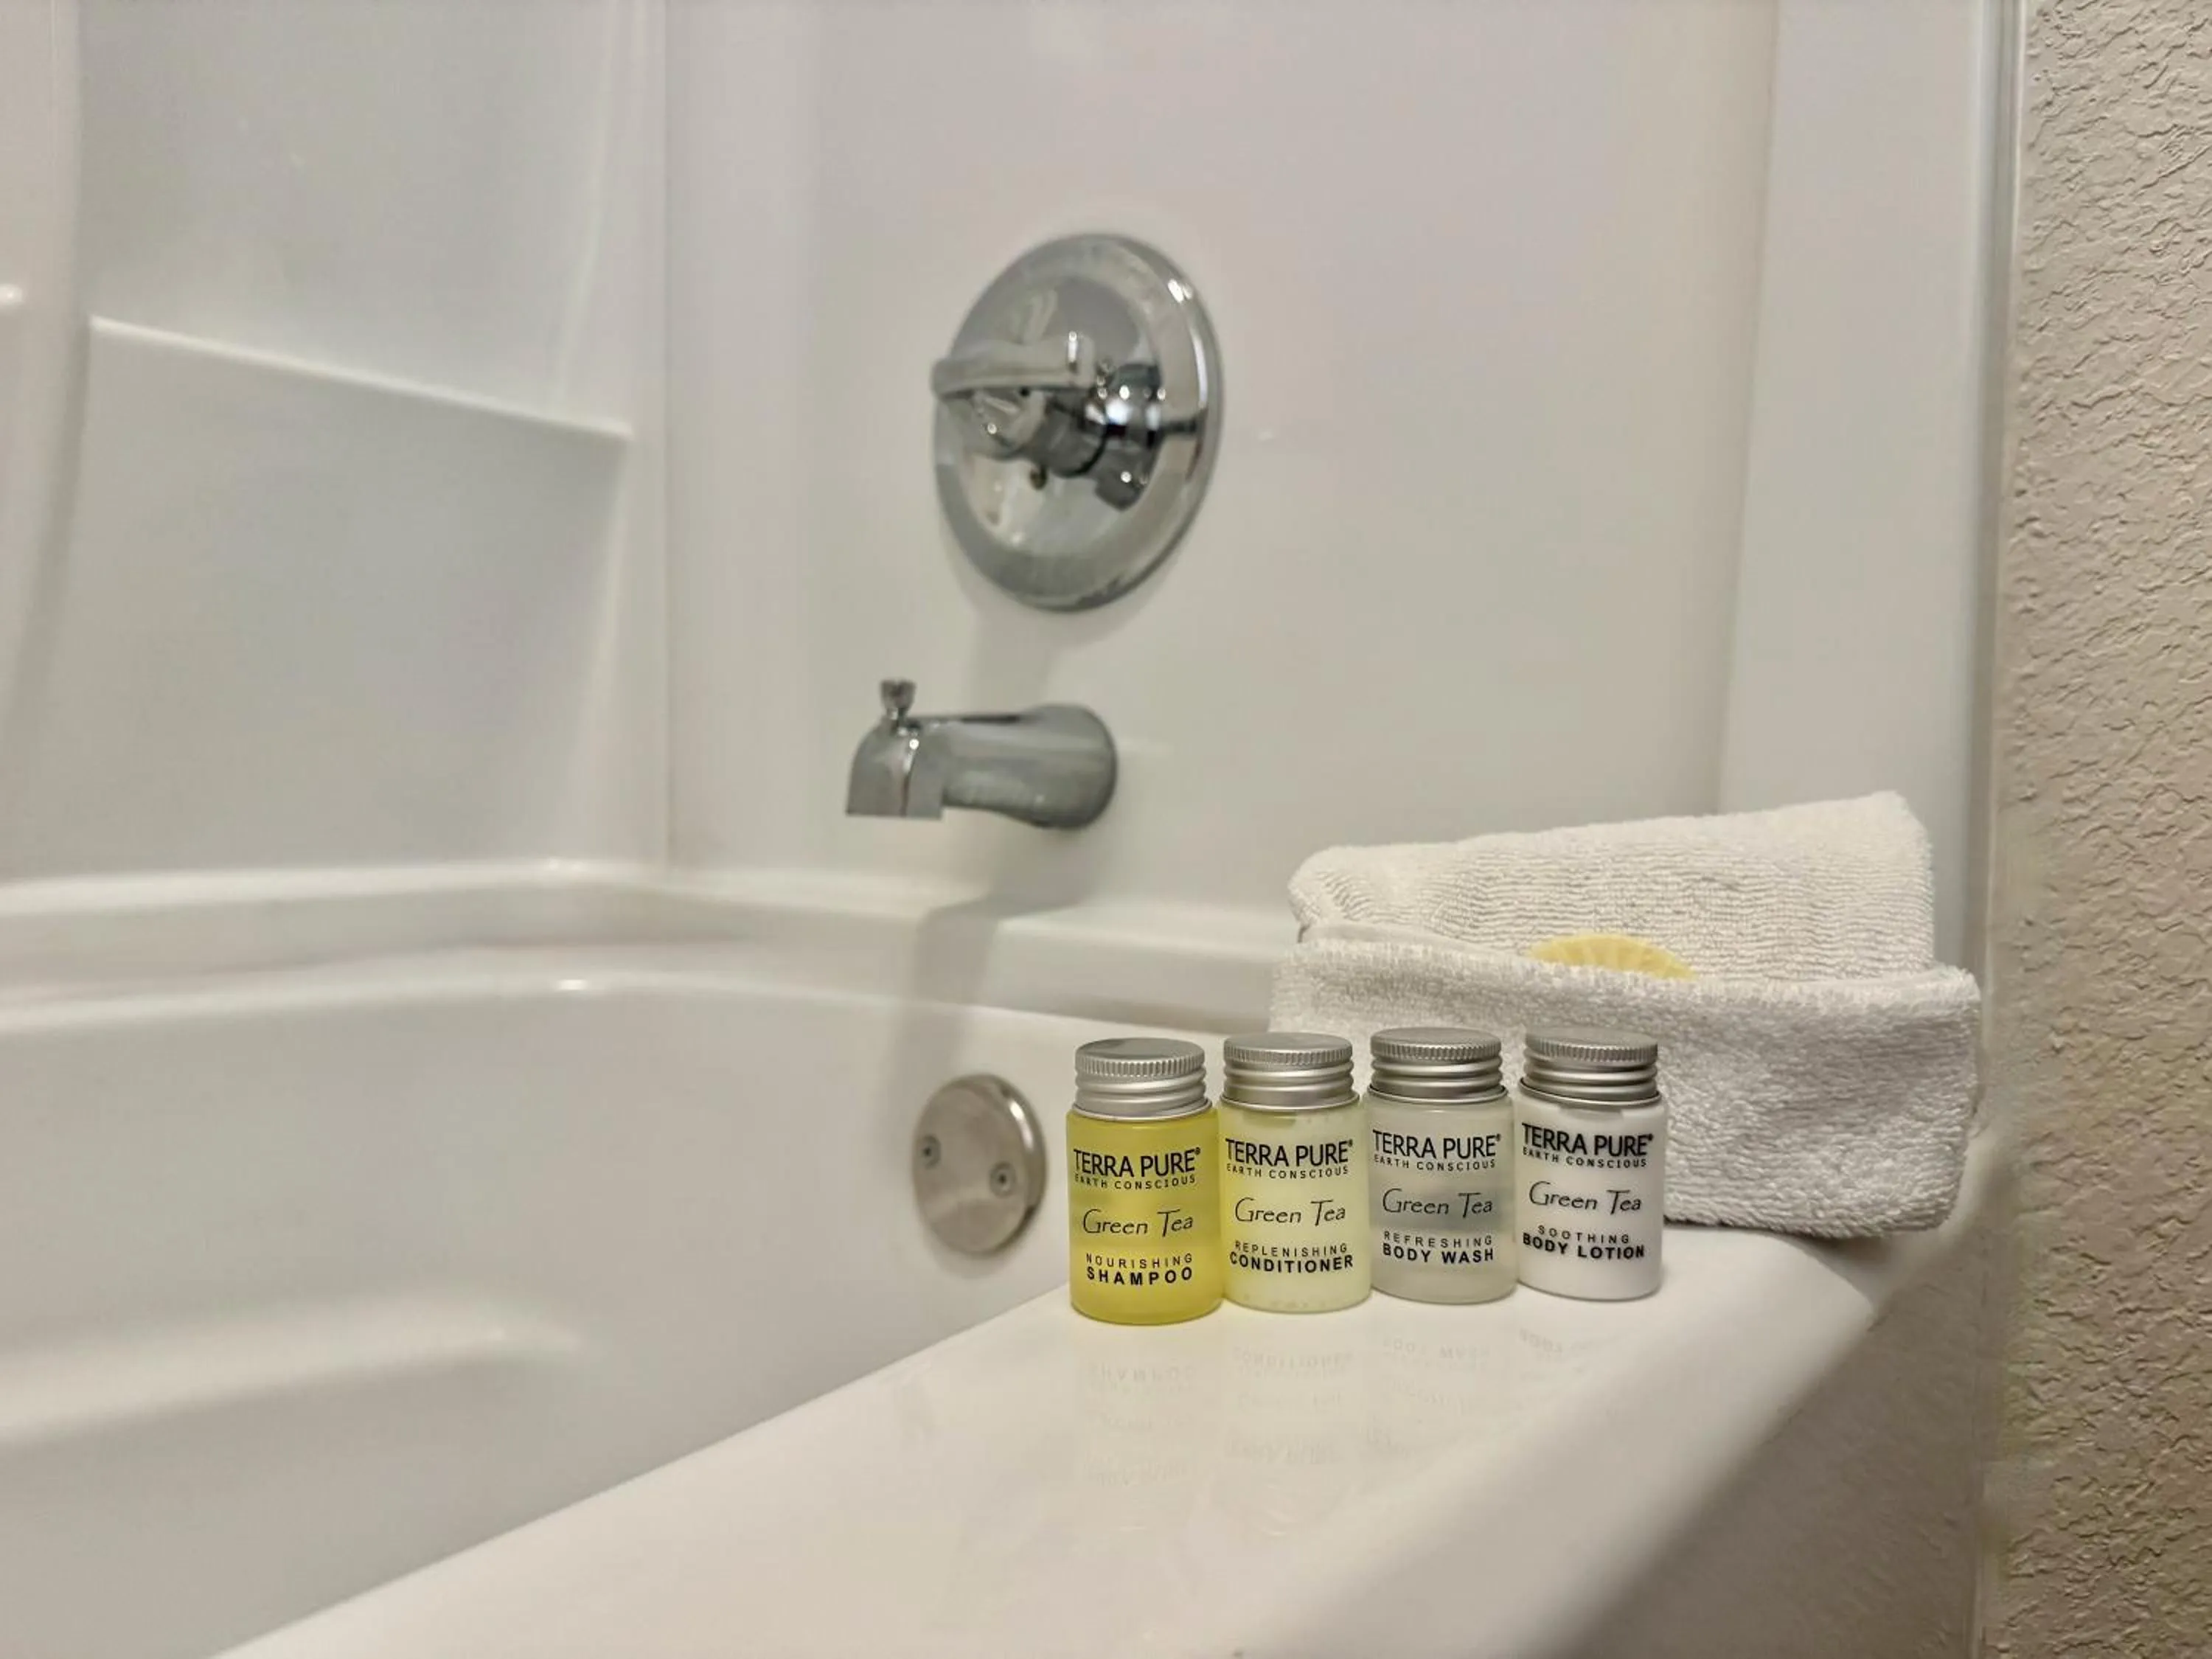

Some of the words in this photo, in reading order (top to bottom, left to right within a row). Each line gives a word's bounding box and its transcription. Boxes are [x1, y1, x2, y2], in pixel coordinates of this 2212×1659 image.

[1372, 1129, 1436, 1159] TERRA
[1522, 1122, 1587, 1155] TERRA
[1225, 1138, 1289, 1166] TERRA
[1374, 1154, 1409, 1169] EARTH
[1416, 1159, 1495, 1172] CONSCIOUS
[1523, 1147, 1559, 1163] EARTH
[1566, 1155, 1646, 1169] CONSCIOUS
[1074, 1149, 1134, 1178] TERRA
[1227, 1164, 1262, 1178] EARTH
[1269, 1165, 1349, 1179] CONSCIOUS
[1074, 1173, 1107, 1188] EARTH
[1115, 1175, 1195, 1189] CONSCIOUS
[1382, 1188, 1449, 1214] Green
[1458, 1192, 1493, 1218] Tea
[1528, 1180, 1598, 1210] Green
[1606, 1189, 1641, 1214] Tea
[1083, 1208, 1148, 1234] Green
[1157, 1208, 1194, 1237] Tea
[1235, 1197, 1301, 1223] Green
[1310, 1199, 1346, 1227] Tea
[1385, 1231, 1492, 1248] REFRESHING
[1538, 1225, 1629, 1243] SOOTHING
[1235, 1240, 1347, 1257] REPLENISHING
[1382, 1243, 1430, 1262] BODY
[1441, 1248, 1493, 1264] WASH
[1523, 1232, 1568, 1254] BODY
[1578, 1245, 1645, 1259] LOTION
[1086, 1253, 1192, 1269] NOURISHING
[1230, 1251, 1353, 1273] CONDITIONER
[1087, 1266, 1192, 1285] SHAMPOO
